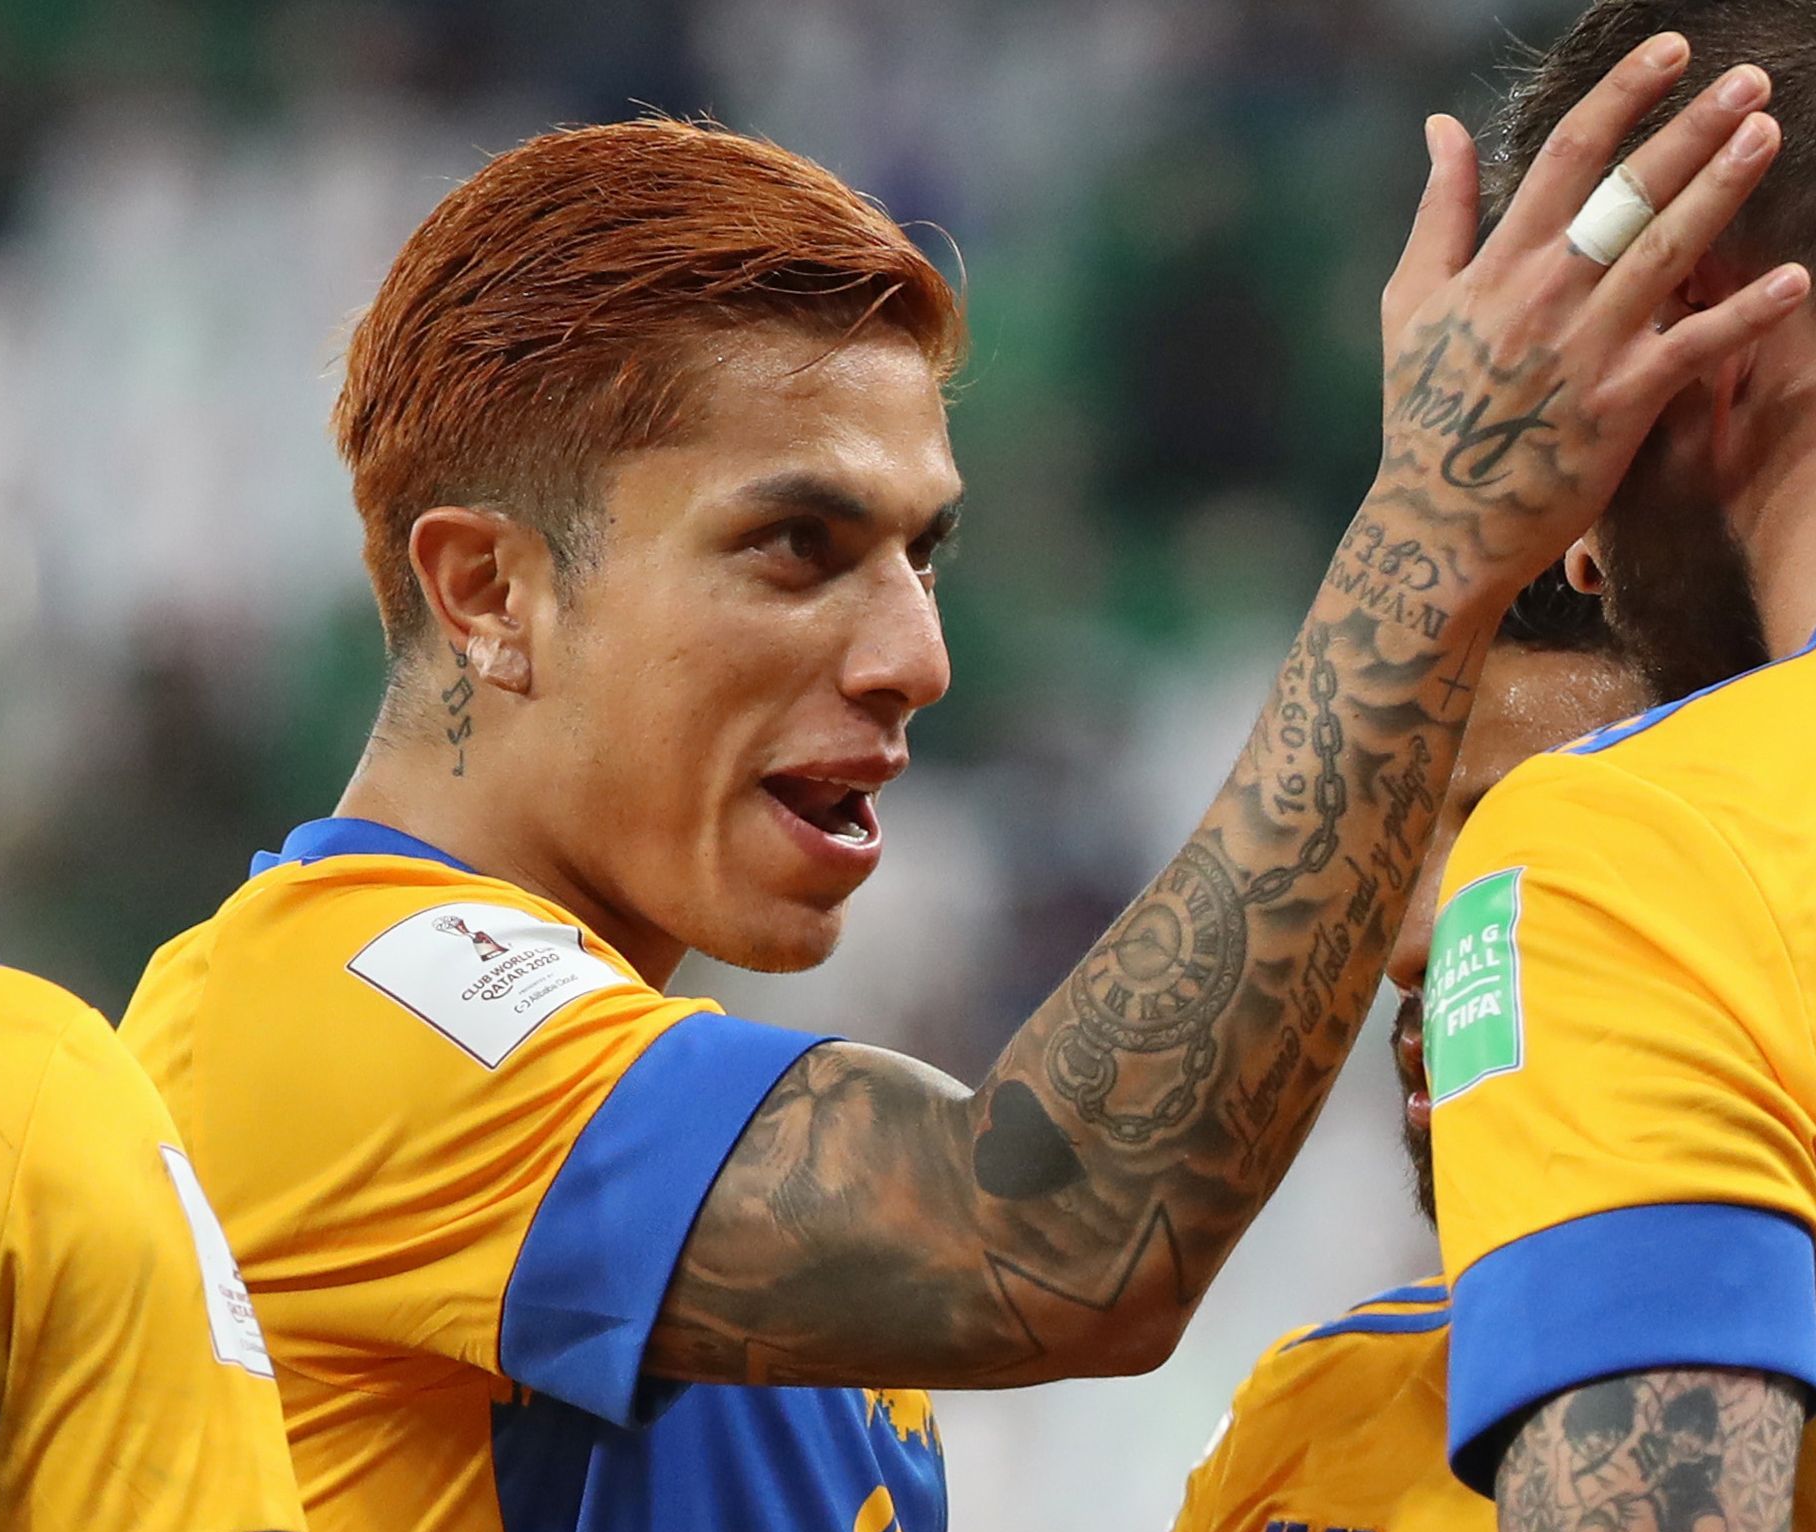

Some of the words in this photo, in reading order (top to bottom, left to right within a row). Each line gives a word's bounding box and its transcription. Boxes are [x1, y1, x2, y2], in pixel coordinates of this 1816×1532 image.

[461, 974, 493, 1001] CLUB
[490, 949, 535, 977] WORLD
[481, 966, 530, 1001] QATAR
[526, 952, 561, 972] 2020
[1446, 993, 1502, 1037] FIFA
